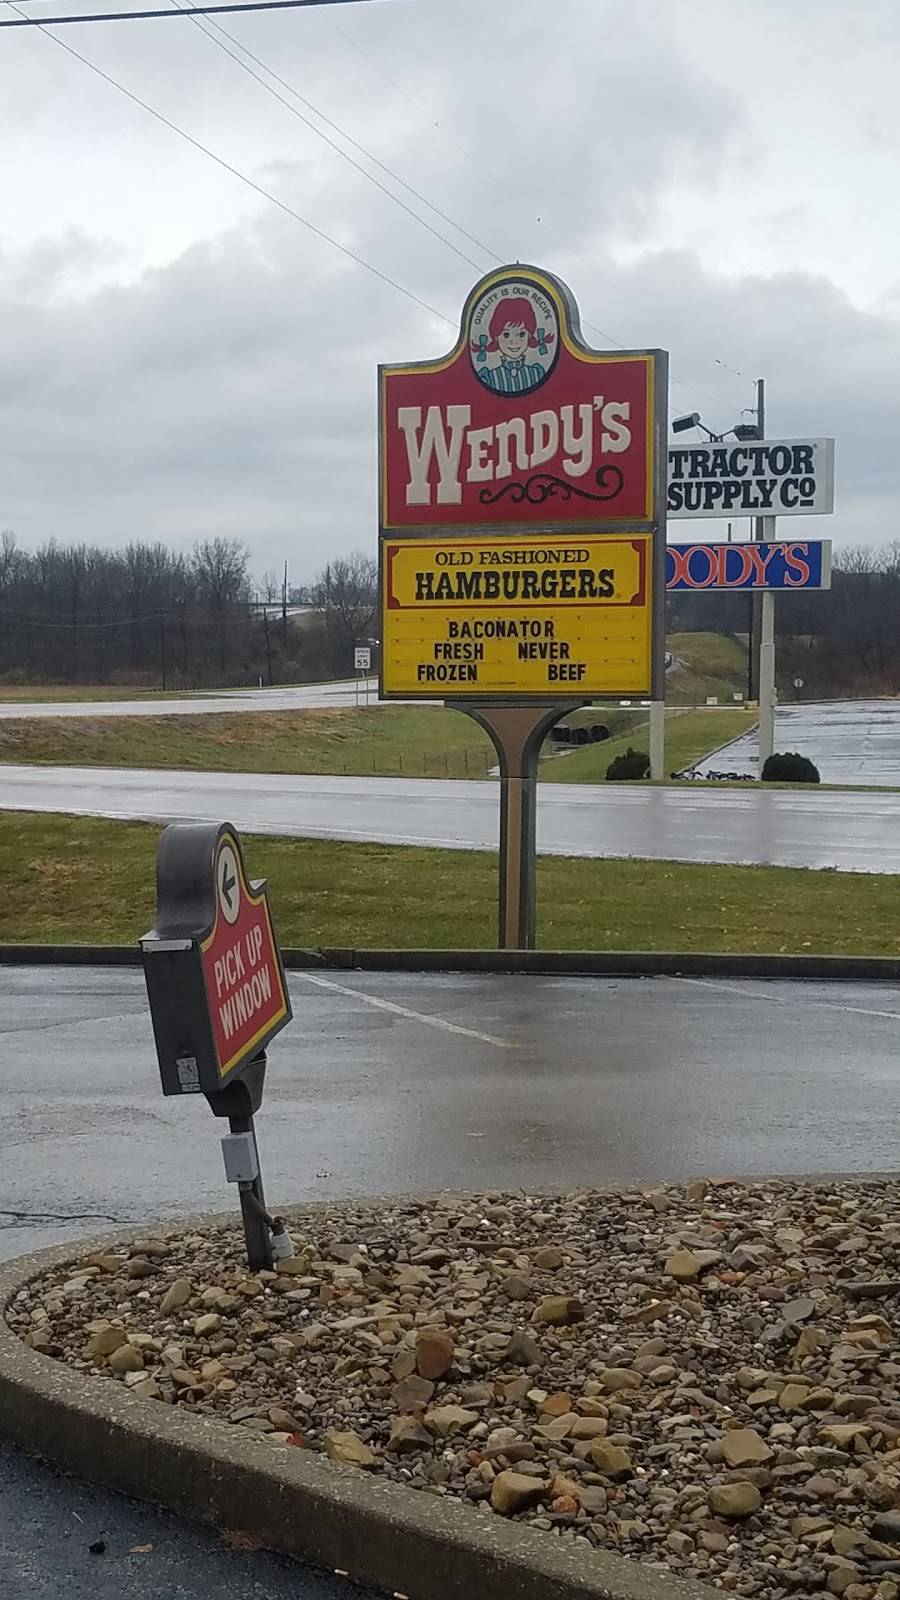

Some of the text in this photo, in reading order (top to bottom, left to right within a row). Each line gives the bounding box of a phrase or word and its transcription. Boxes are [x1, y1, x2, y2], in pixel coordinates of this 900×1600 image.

[474, 287, 552, 325] QUALITY IS OUR RECIPE
[669, 445, 814, 480] TRACTOR
[667, 478, 778, 512] SUPPLY
[435, 549, 590, 566] OLD FASHIONED
[415, 569, 615, 600] HAMBURGERS
[449, 620, 555, 638] BACONATOR
[434, 642, 569, 660] FRESH NEVER
[417, 664, 586, 681] FROZEN BEEF
[214, 925, 262, 998] PICK UP
[219, 965, 272, 1040] WINDOW
